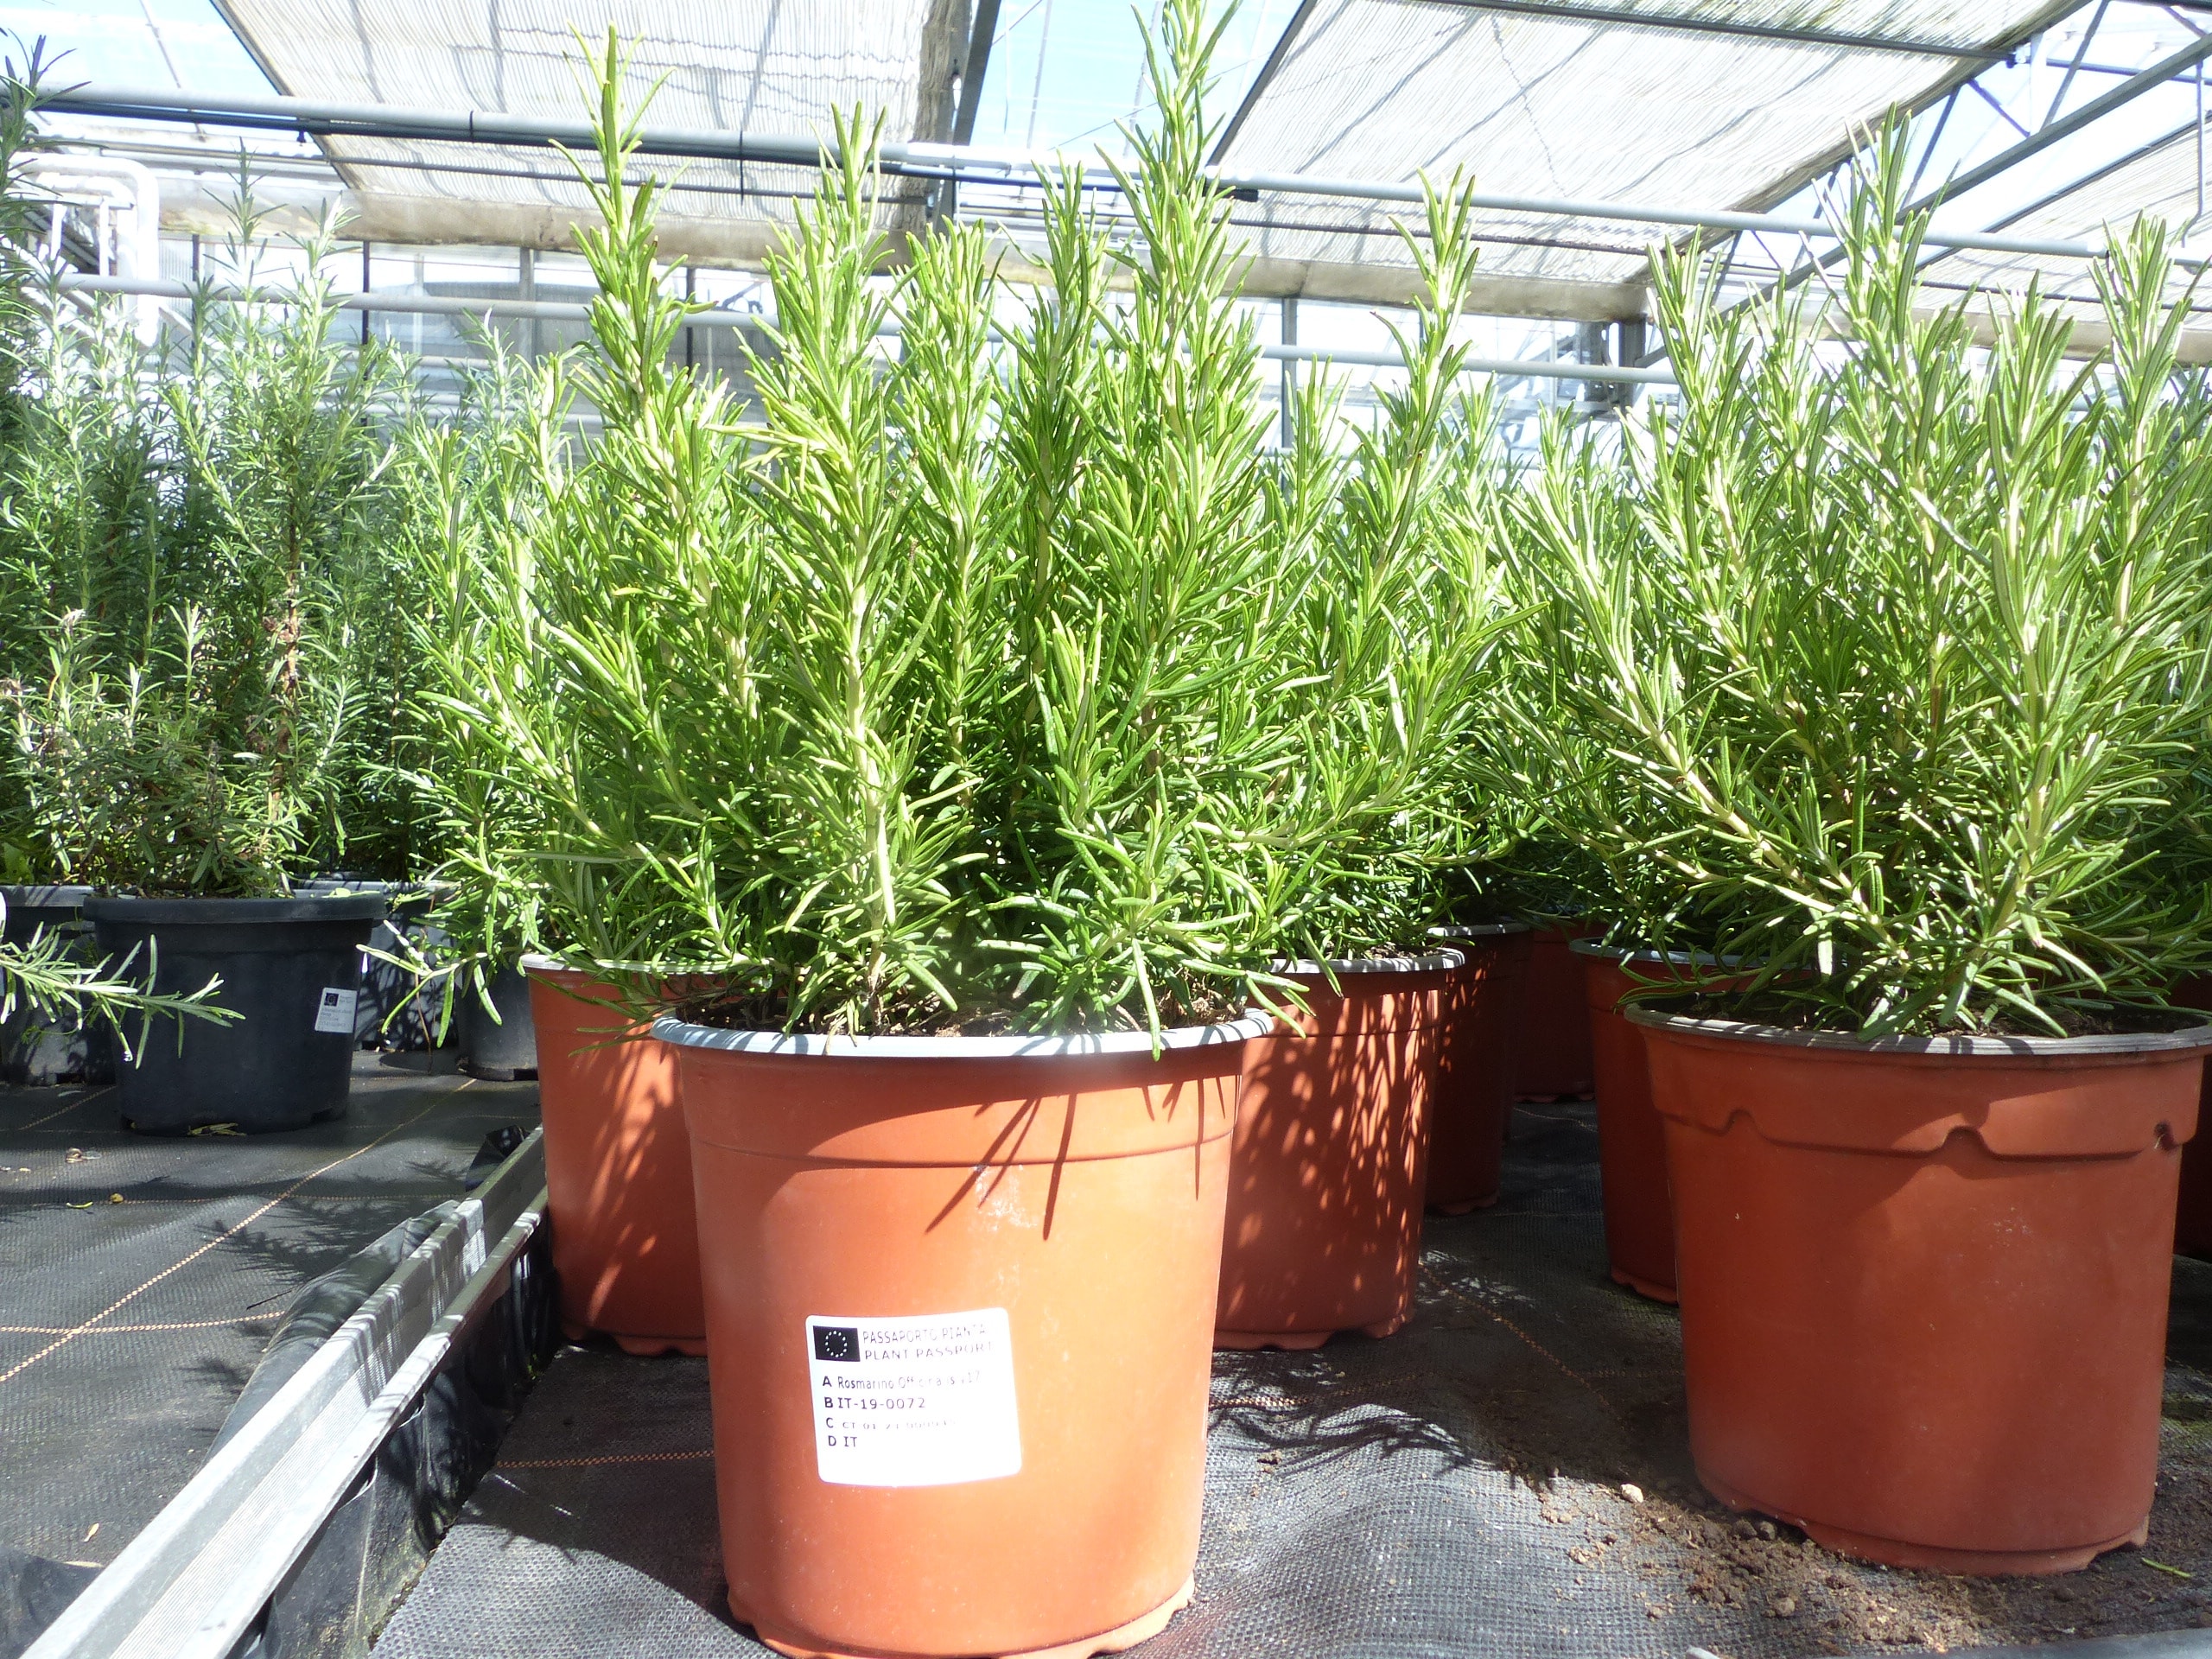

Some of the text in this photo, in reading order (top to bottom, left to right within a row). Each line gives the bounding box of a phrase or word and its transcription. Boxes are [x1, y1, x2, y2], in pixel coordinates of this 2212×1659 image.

[943, 1324, 986, 1339] PIANA
[865, 1350, 909, 1361] PLANT
[822, 1376, 832, 1387] A
[824, 1396, 926, 1410] B IT-19-0072
[826, 1417, 834, 1428] C
[828, 1435, 858, 1447] D IT
